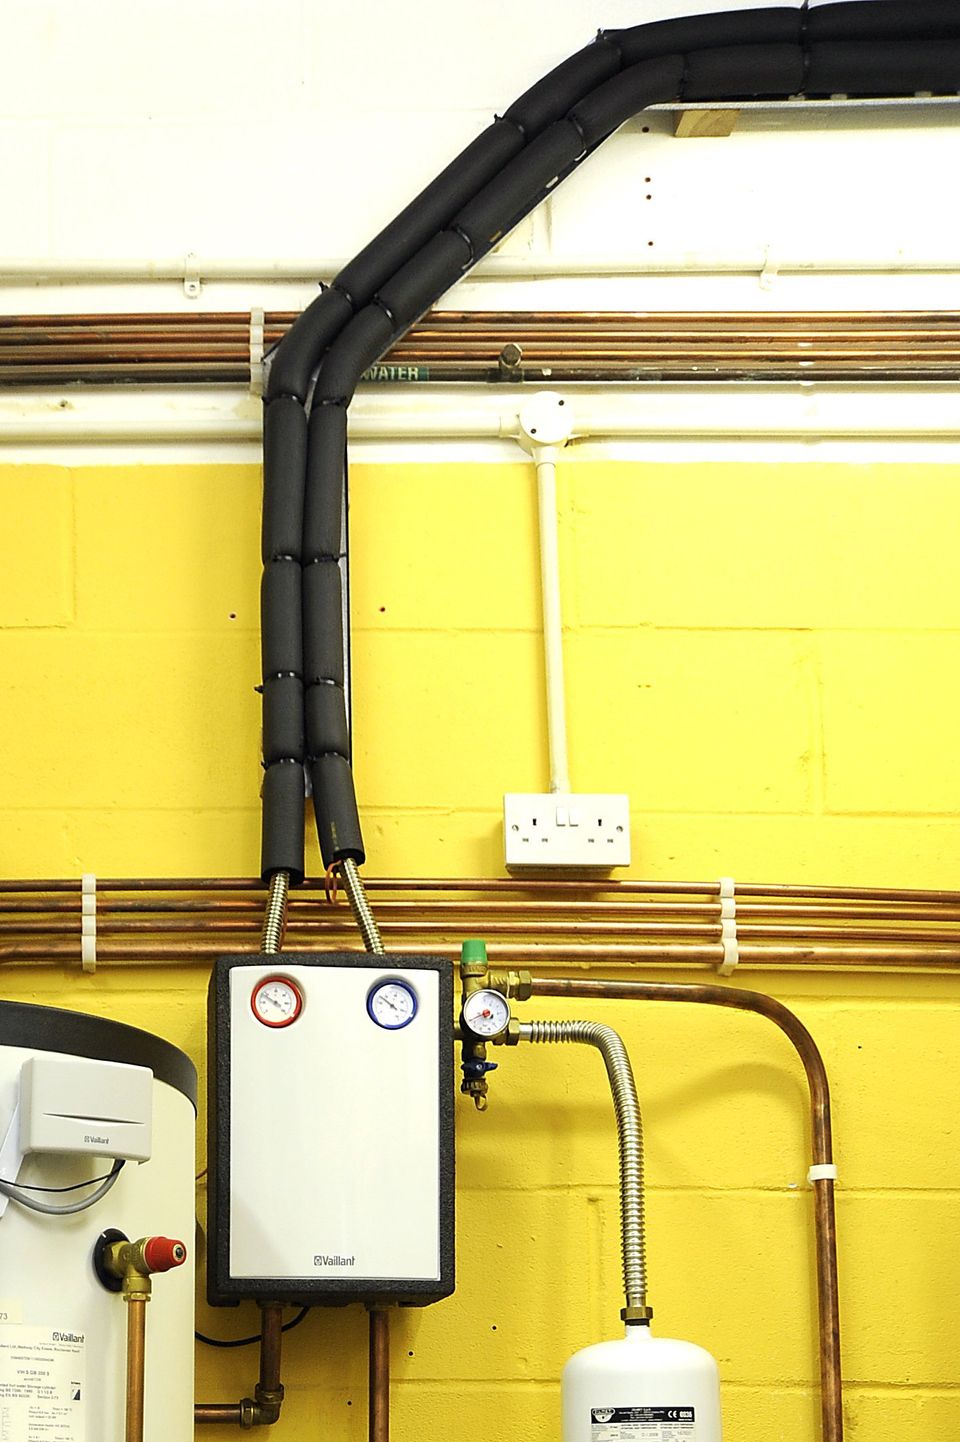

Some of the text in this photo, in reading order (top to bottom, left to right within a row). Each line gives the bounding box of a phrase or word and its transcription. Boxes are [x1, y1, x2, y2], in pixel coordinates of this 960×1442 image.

[90, 1135, 110, 1145] Vaillant
[322, 1255, 356, 1266] Vaillant
[59, 1332, 85, 1343] Vaillant
